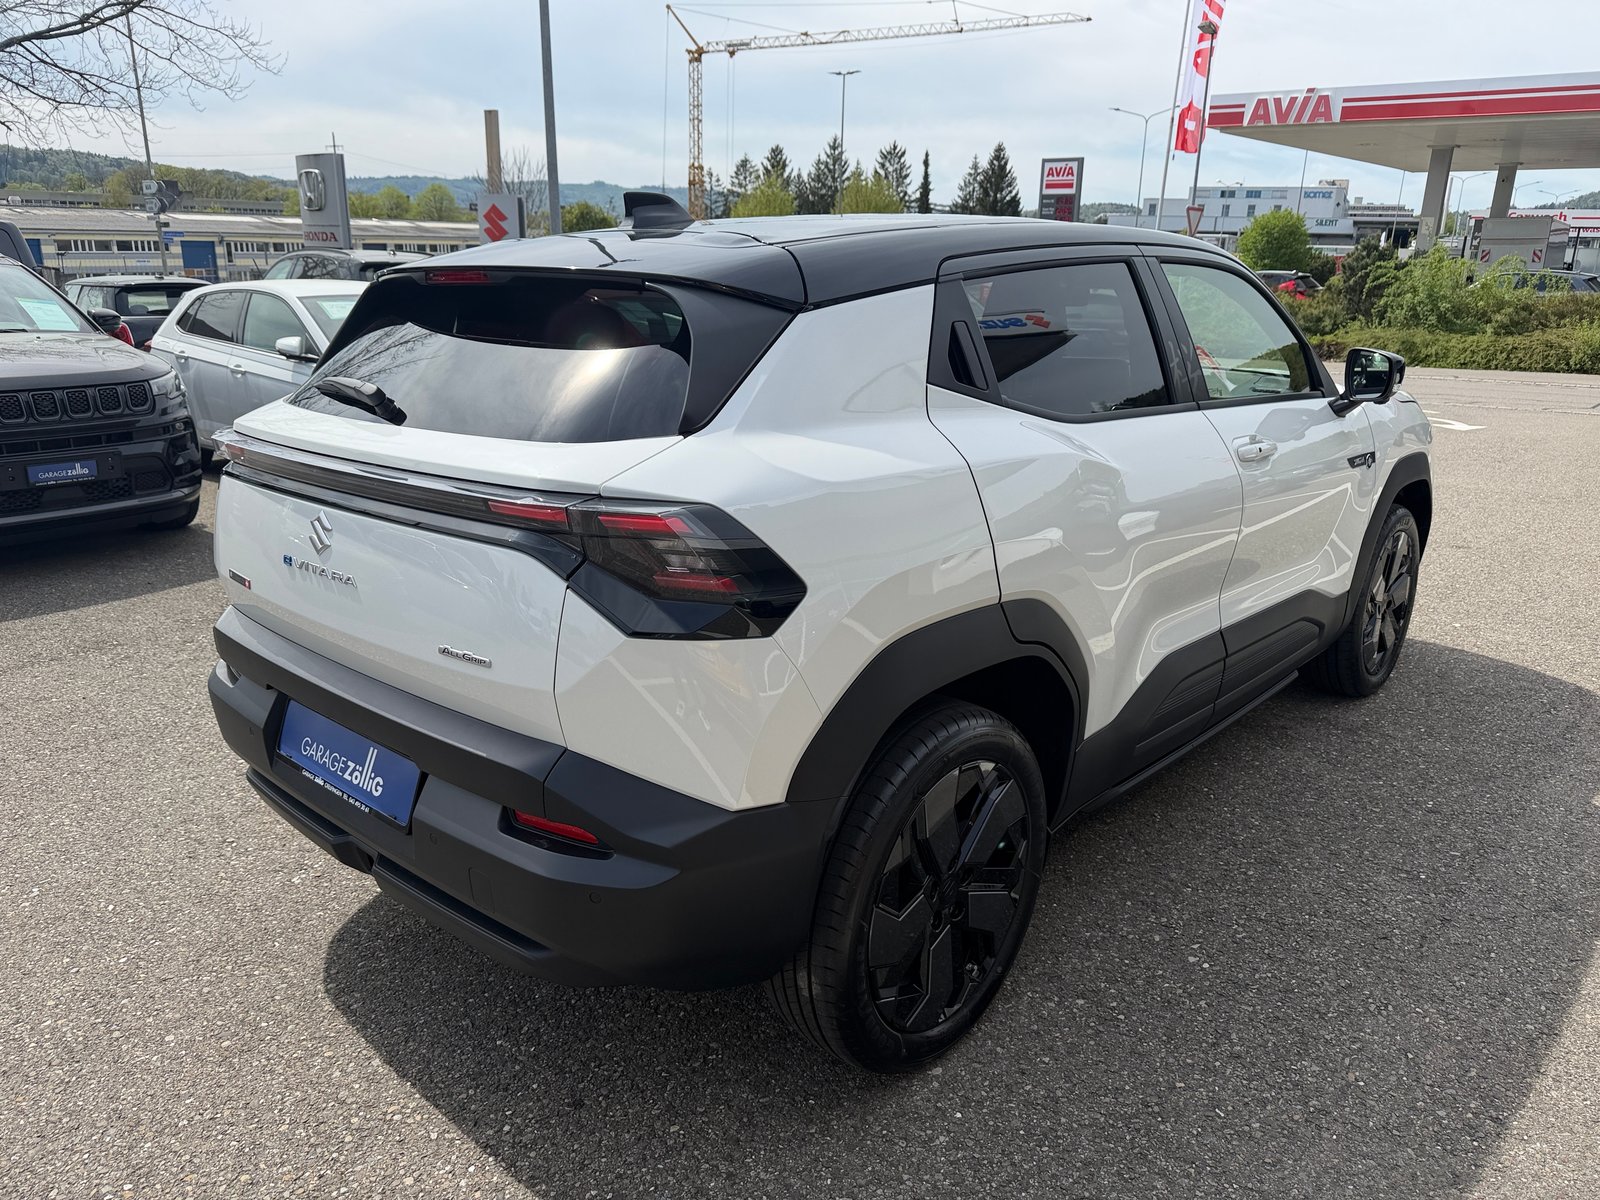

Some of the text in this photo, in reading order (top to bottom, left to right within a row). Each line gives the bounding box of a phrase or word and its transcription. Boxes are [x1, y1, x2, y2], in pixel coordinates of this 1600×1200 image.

[1246, 87, 1334, 126] AVIA
[1046, 163, 1075, 178] AVIA
[303, 231, 338, 242] HONDA
